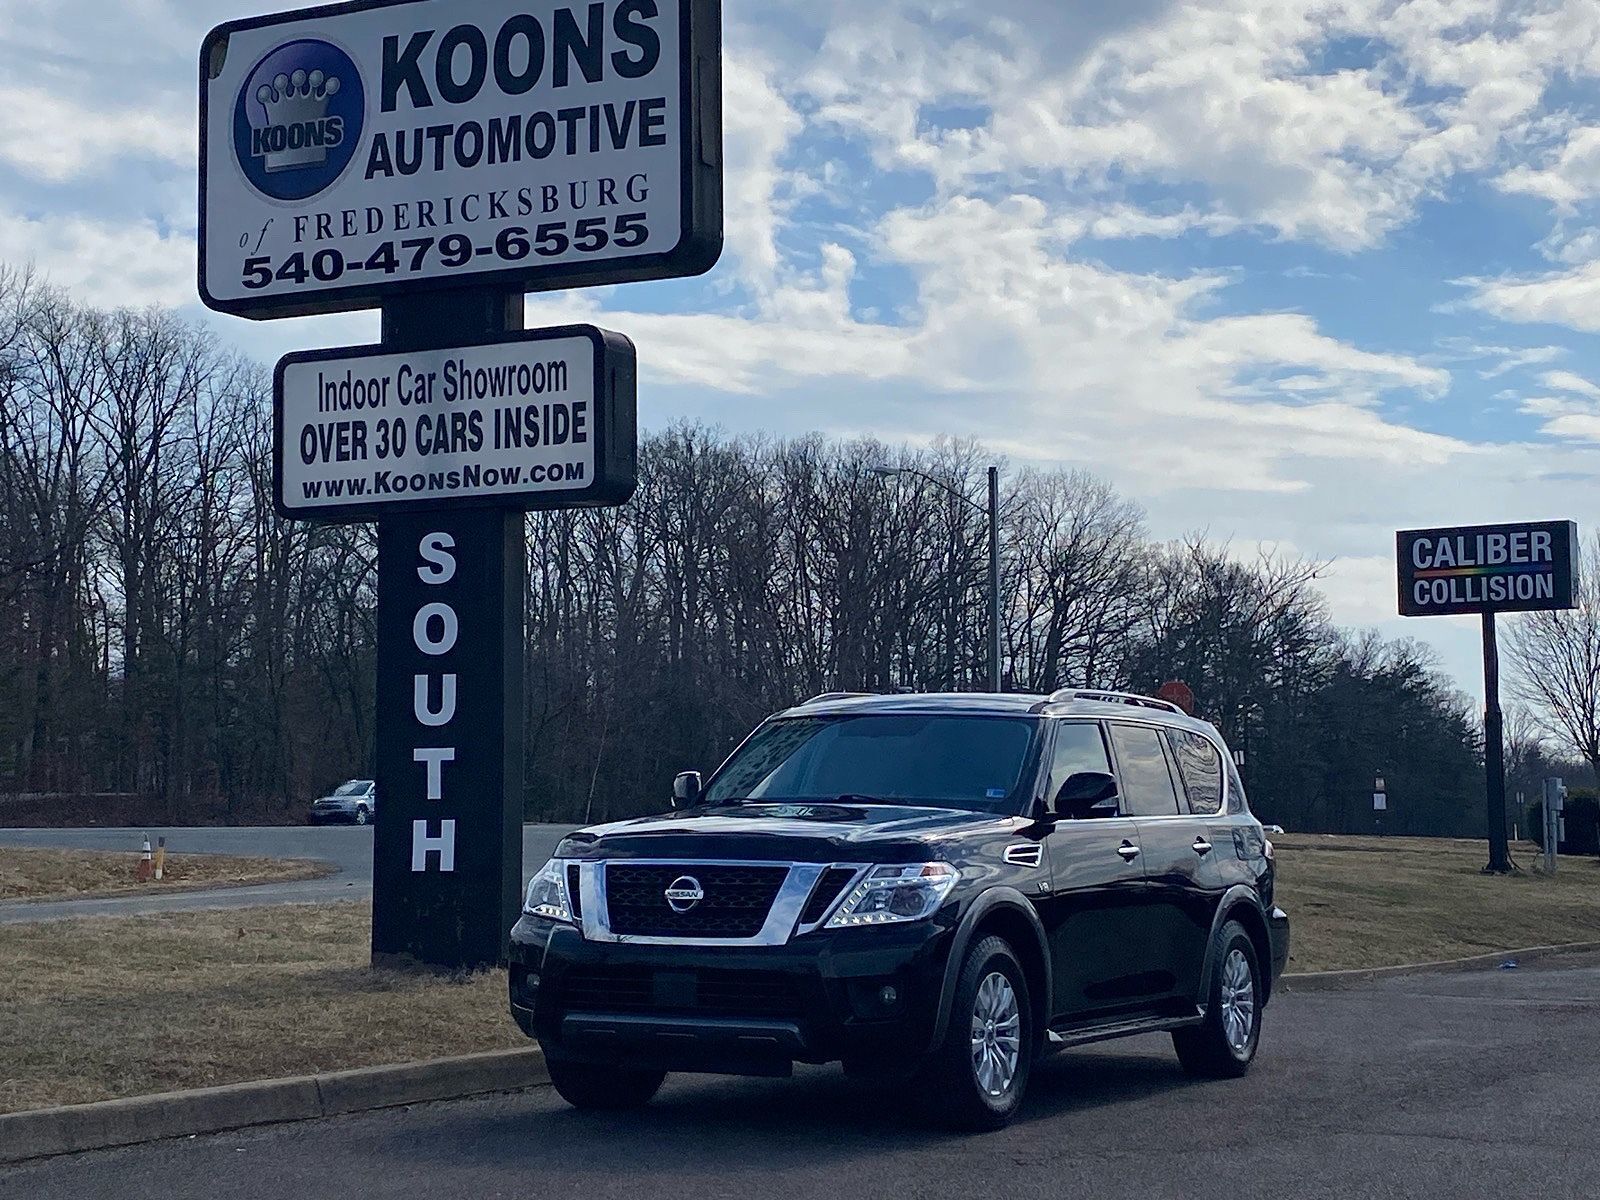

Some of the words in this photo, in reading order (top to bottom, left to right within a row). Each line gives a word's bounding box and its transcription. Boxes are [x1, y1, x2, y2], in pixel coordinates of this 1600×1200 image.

[380, 0, 661, 113] KOONS
[251, 116, 344, 156] KOONS
[364, 97, 667, 180] AUTOMOTIVE
[239, 218, 274, 255] of
[293, 173, 650, 243] FREDERICKSBURG
[241, 212, 650, 290] 540-479-6555
[318, 369, 390, 412] Indoor
[397, 364, 435, 406] Car
[443, 359, 567, 403] Showroom
[300, 420, 367, 465] OVER
[375, 417, 407, 459] 30
[415, 409, 483, 456] CARS
[494, 401, 587, 450] INSIDE
[1412, 531, 1552, 569] CALIBER
[1413, 573, 1553, 605] COLLISION
[411, 531, 458, 872] SOUTH
